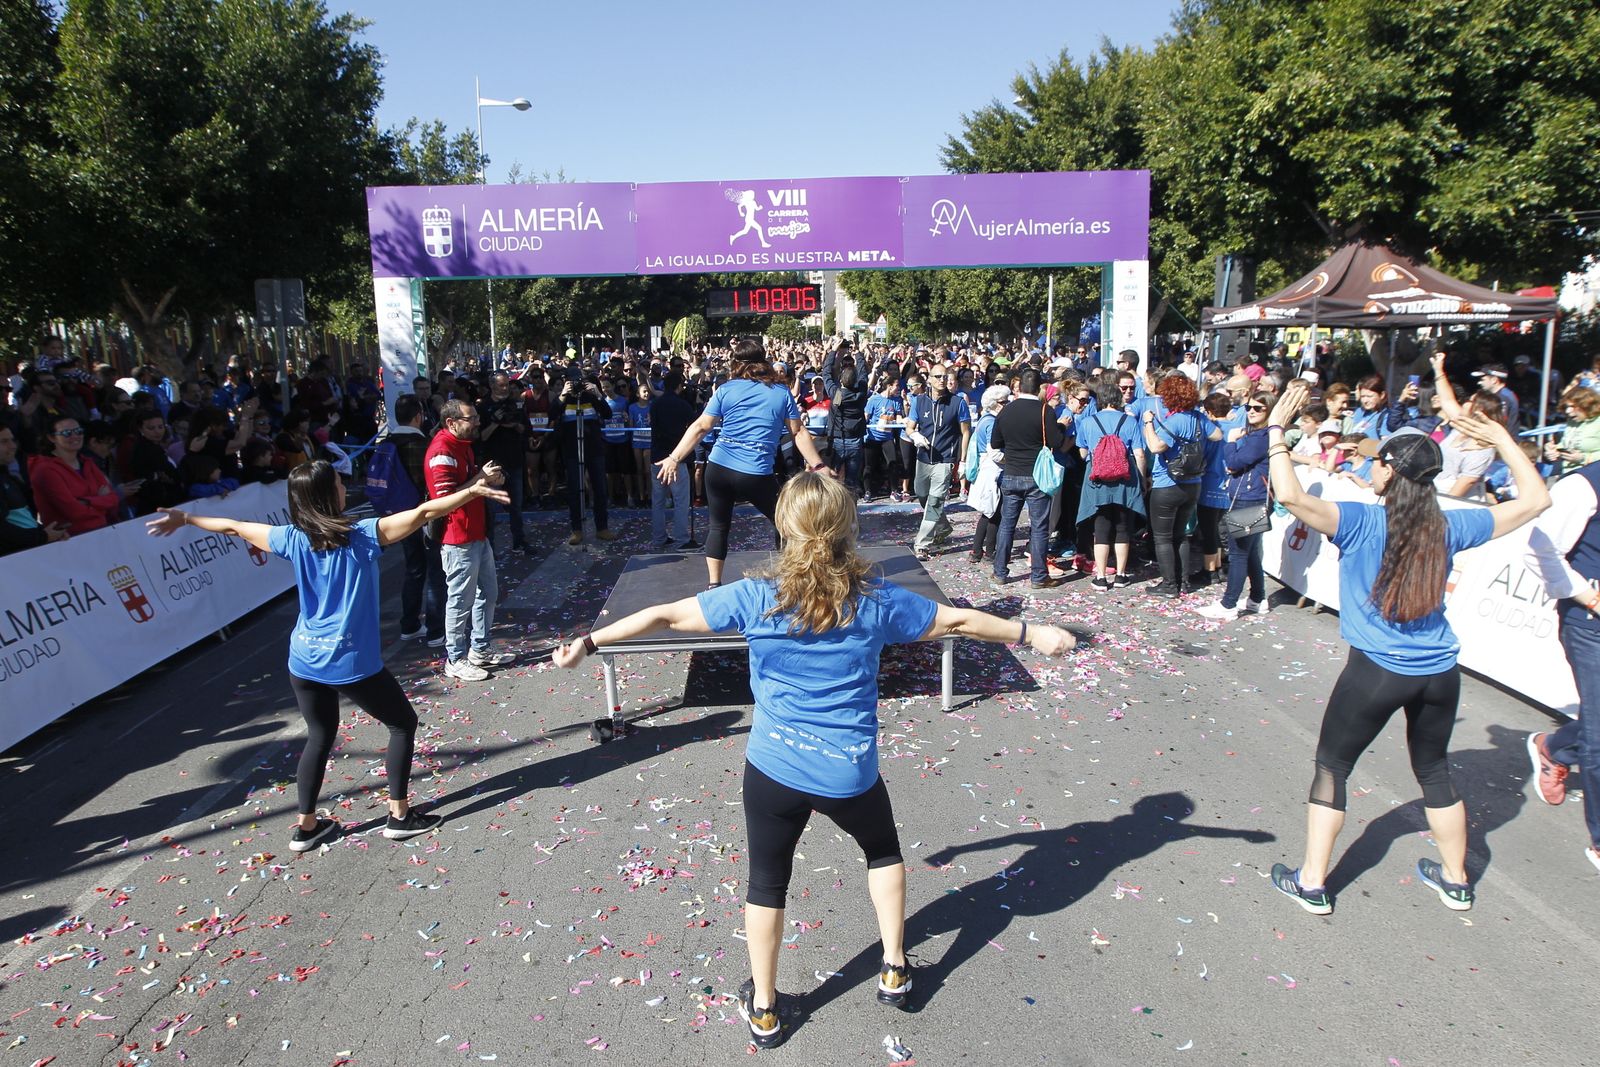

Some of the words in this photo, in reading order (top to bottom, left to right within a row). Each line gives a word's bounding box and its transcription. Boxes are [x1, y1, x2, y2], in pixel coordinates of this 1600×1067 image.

[767, 189, 807, 207] VIII
[478, 201, 604, 233] ALMERÍA
[767, 209, 809, 217] CARRERA
[479, 235, 543, 253] CIUDAD
[645, 256, 664, 268] LA
[668, 254, 747, 267] IGUALDAD
[752, 253, 770, 265] ES
[774, 251, 844, 265] NUESTRA
[847, 249, 897, 263] META.
[168, 570, 214, 601] CIUDAD
[0, 578, 107, 650] LMERÍA
